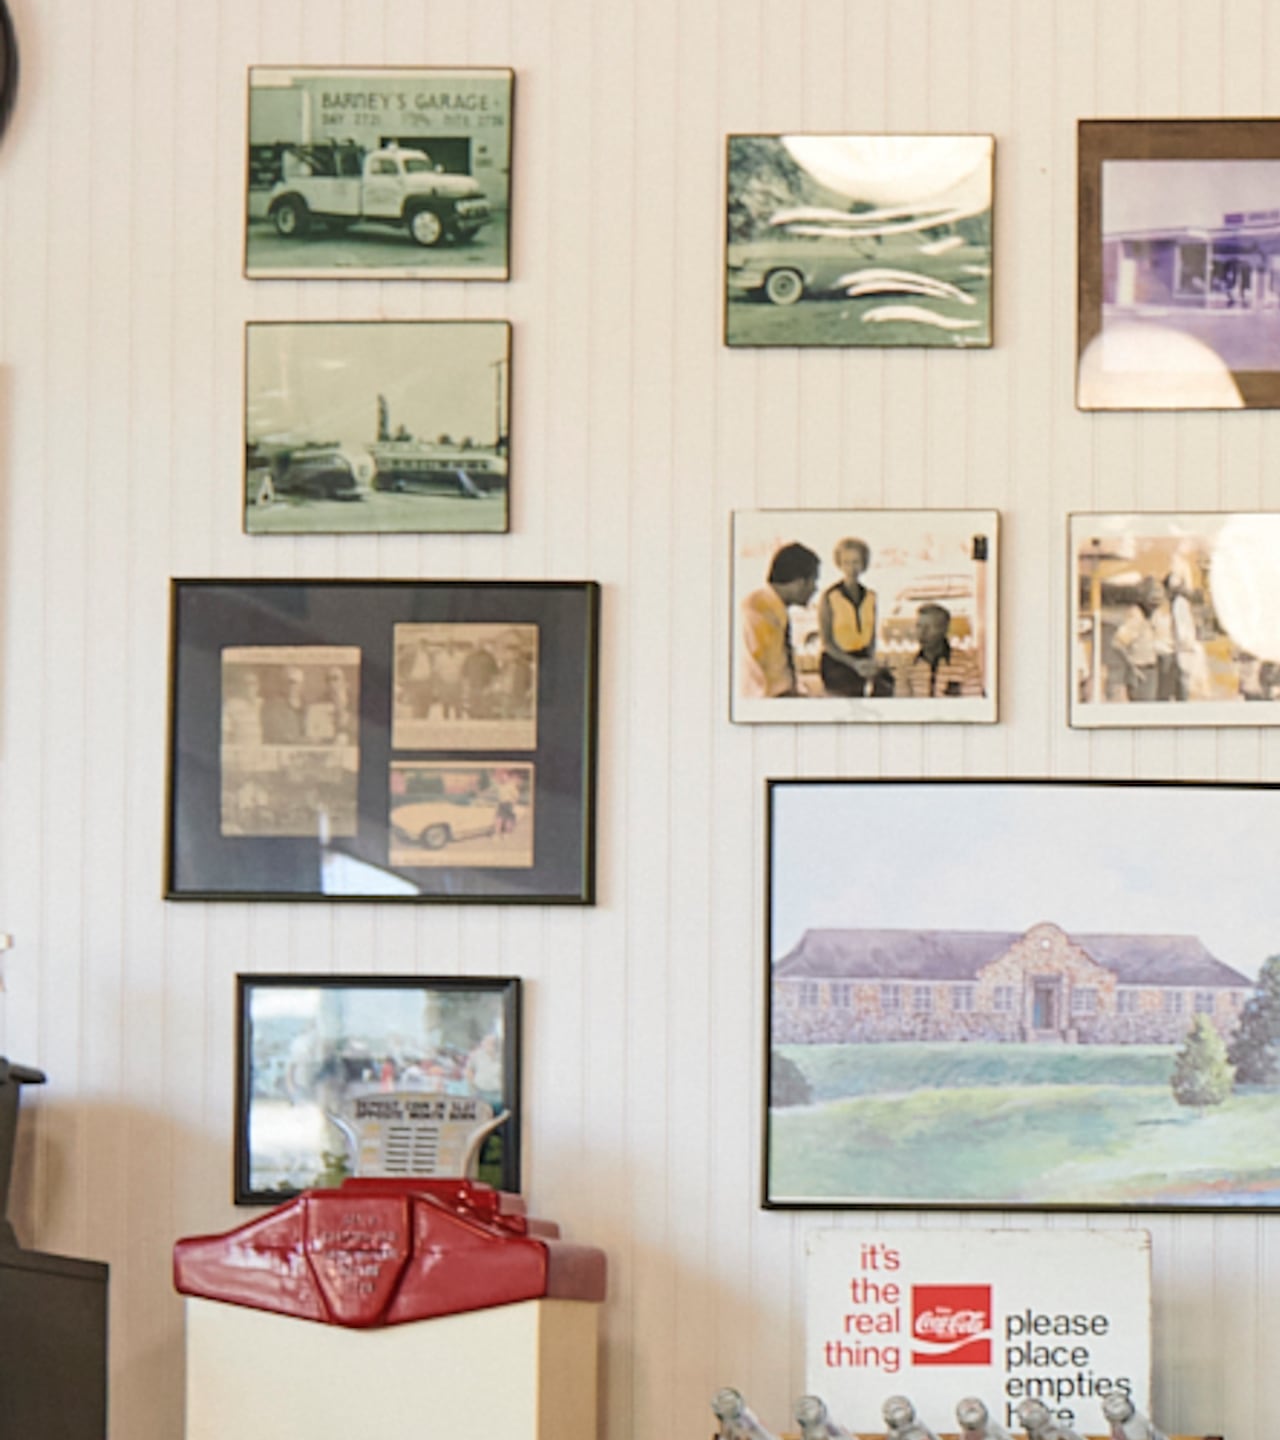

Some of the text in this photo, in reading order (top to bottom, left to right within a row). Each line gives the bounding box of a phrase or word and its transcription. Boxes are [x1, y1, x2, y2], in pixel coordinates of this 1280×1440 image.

[414, 92, 488, 111] GARAGE
[860, 1243, 901, 1271] it's
[850, 1276, 901, 1305] the
[843, 1307, 901, 1334] real
[1005, 1309, 1110, 1341] please
[824, 1340, 901, 1374] thing
[1005, 1341, 1090, 1373] place
[1005, 1372, 1133, 1404] empties
